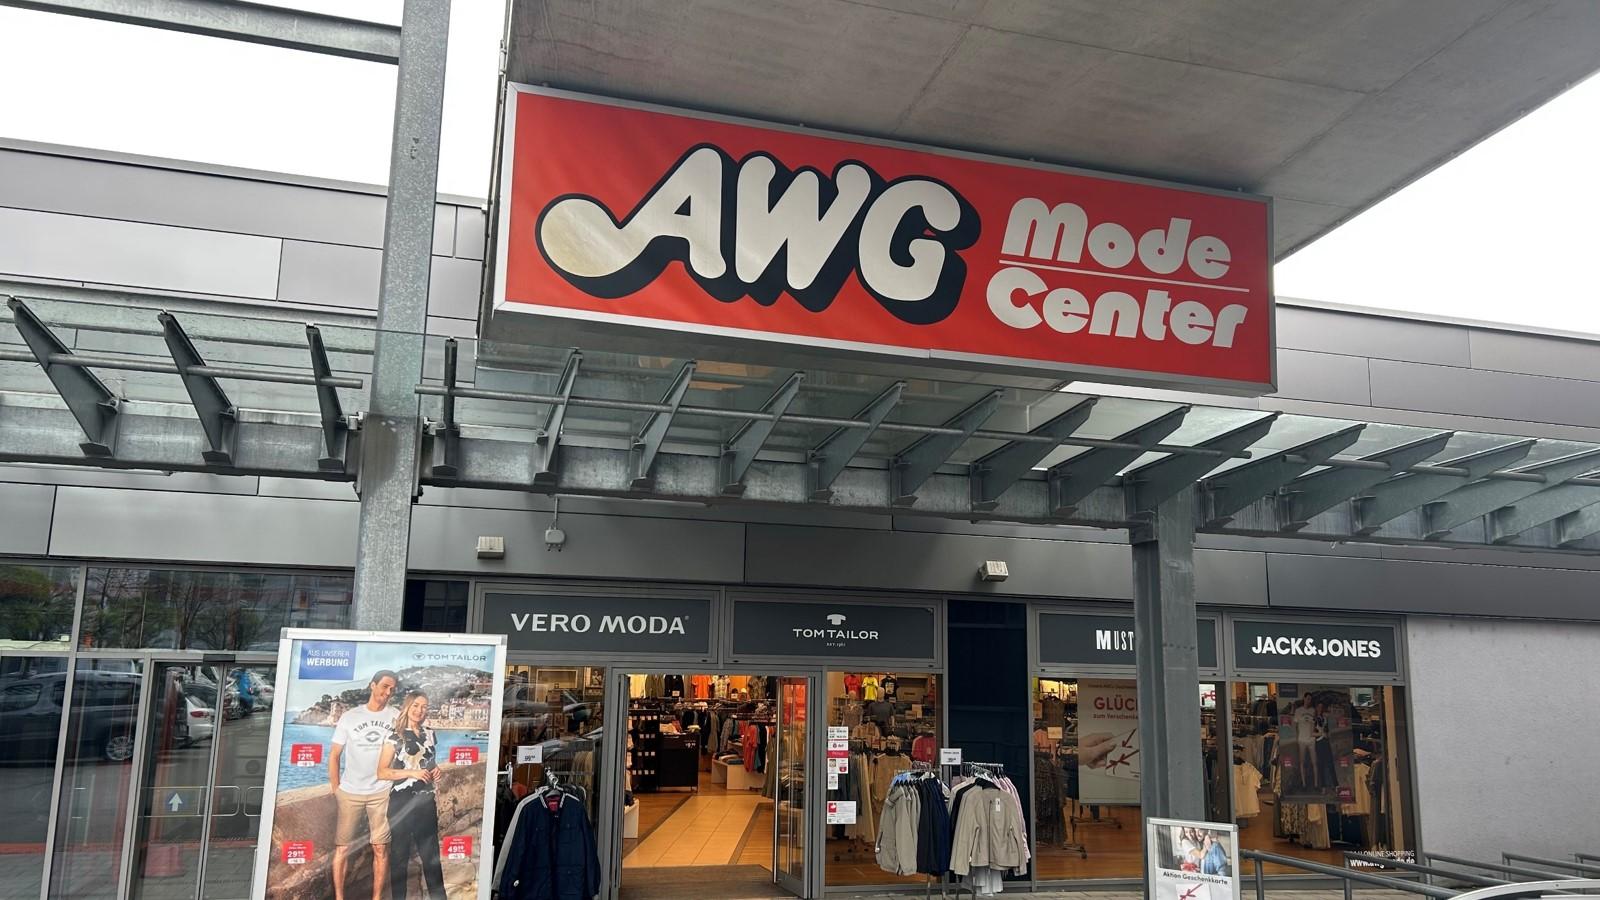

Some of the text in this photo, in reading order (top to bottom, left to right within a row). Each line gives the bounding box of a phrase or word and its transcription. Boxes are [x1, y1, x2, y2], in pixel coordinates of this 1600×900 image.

[540, 146, 964, 303] AWG
[1001, 197, 1232, 280] Mode
[986, 266, 1249, 349] Center
[510, 612, 686, 635] VERO MODA
[792, 628, 879, 640] TOM TAILOR
[1095, 629, 1134, 651] MUST
[306, 649, 350, 658] AUS UNSERER
[1251, 634, 1381, 658] JACK&JONES
[306, 657, 350, 668] WERBUNG
[427, 653, 488, 662] TOM TAILOR
[1093, 694, 1138, 712] GLÜC
[353, 722, 369, 733] TOM
[1162, 871, 1228, 885] Aktion Geschenkkarte
